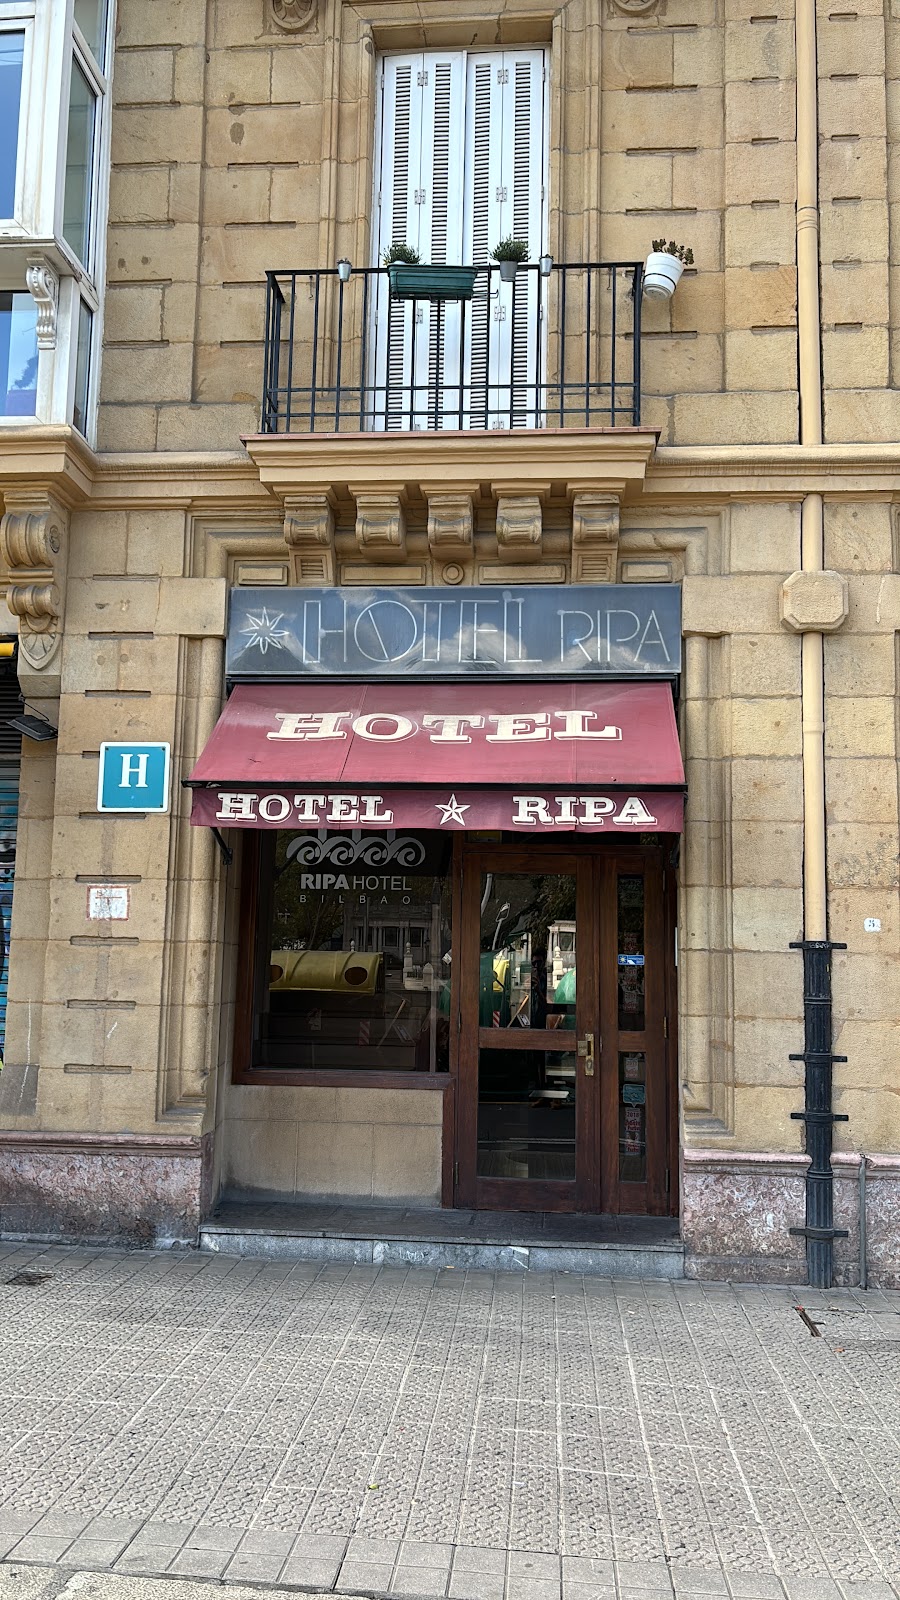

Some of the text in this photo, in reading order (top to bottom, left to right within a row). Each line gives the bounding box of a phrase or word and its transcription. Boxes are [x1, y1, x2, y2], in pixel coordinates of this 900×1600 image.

[302, 596, 671, 664] HOTEL RIPA
[266, 709, 623, 744] HOTEL
[118, 753, 149, 788] H
[215, 792, 658, 826] HOTEL RIPA
[300, 873, 412, 891] RIPA HOTEL
[299, 895, 411, 904] BILBAO
